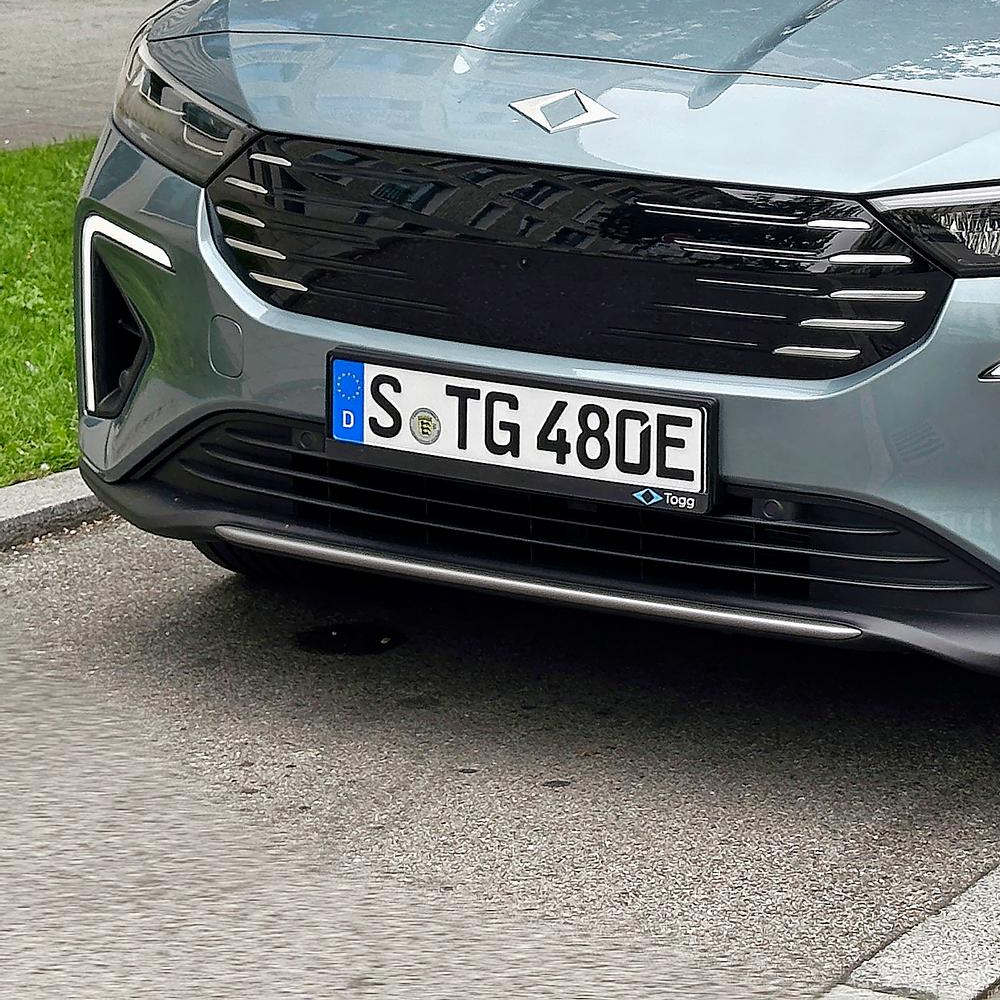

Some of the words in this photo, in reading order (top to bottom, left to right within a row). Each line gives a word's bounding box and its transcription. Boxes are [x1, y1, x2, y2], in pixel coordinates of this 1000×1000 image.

[342, 410, 355, 428] D
[368, 374, 403, 438] S
[446, 384, 520, 458] TG
[537, 401, 694, 481] 480E
[664, 492, 695, 509] Togg
